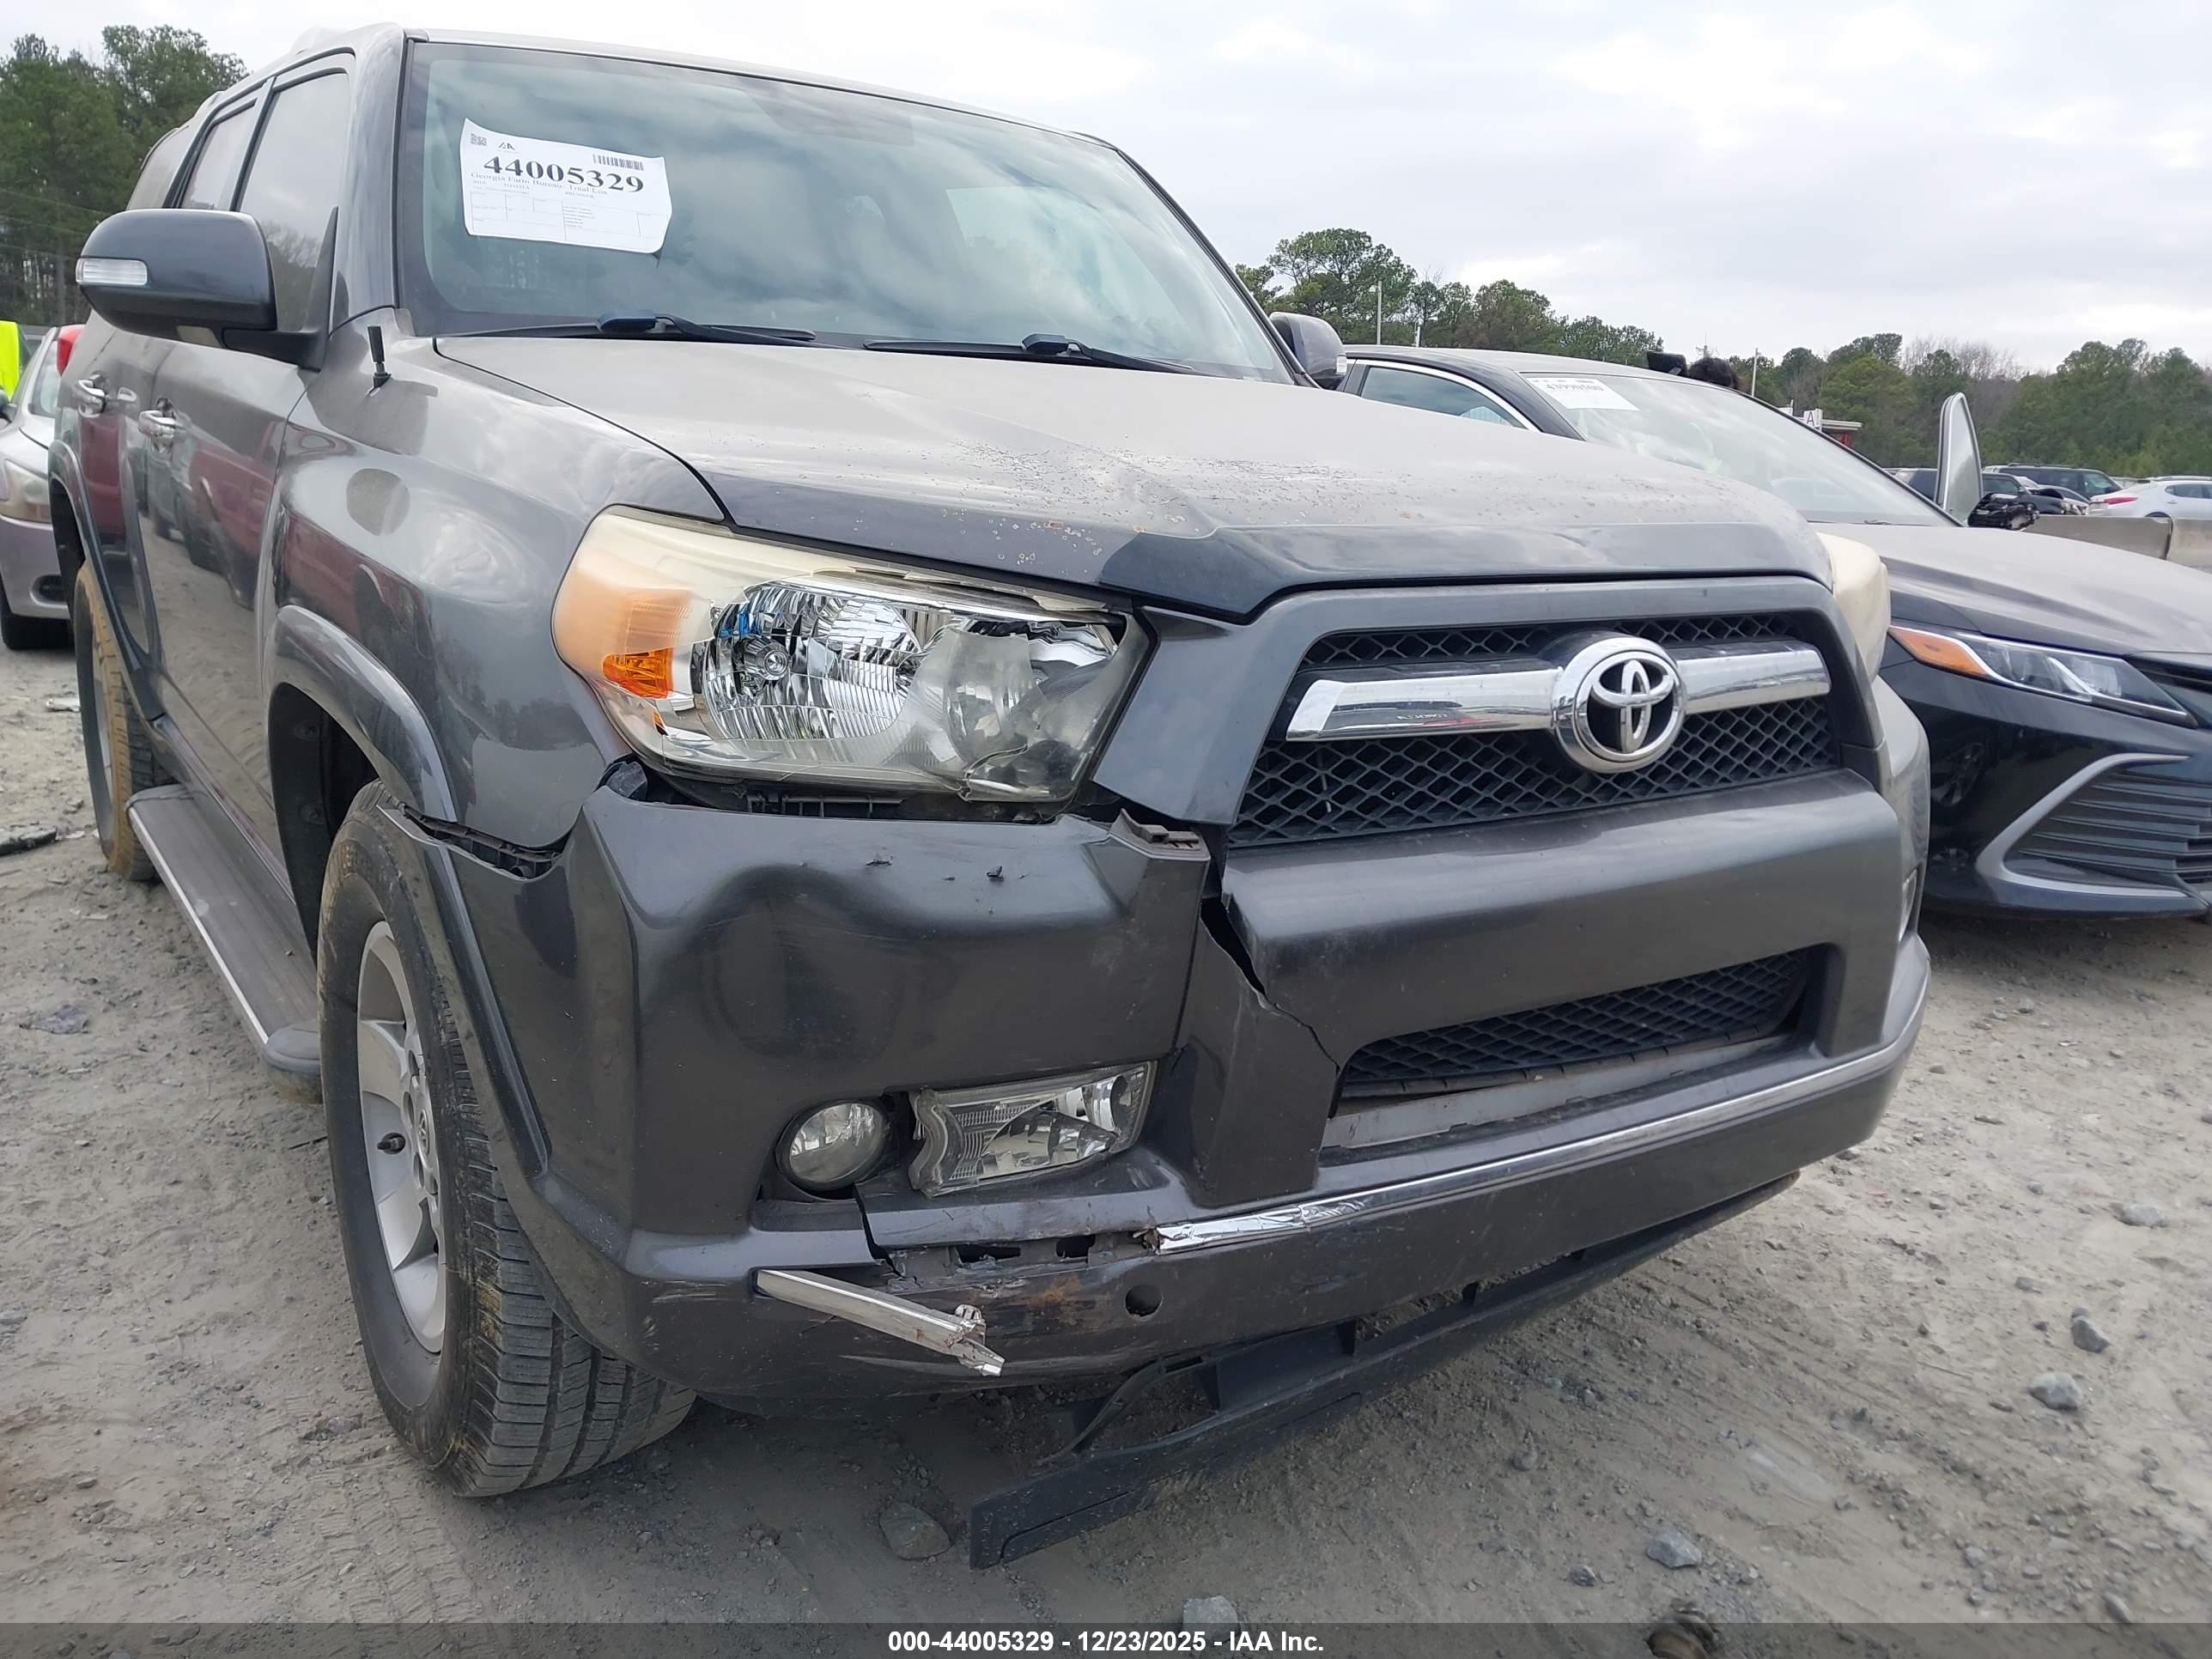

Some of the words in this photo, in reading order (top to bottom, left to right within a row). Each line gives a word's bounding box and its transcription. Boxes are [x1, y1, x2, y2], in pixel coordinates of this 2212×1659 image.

[471, 172, 506, 182] Georgia
[507, 175, 531, 185] Farm
[568, 184, 591, 193] Total
[483, 155, 645, 193] 44005329
